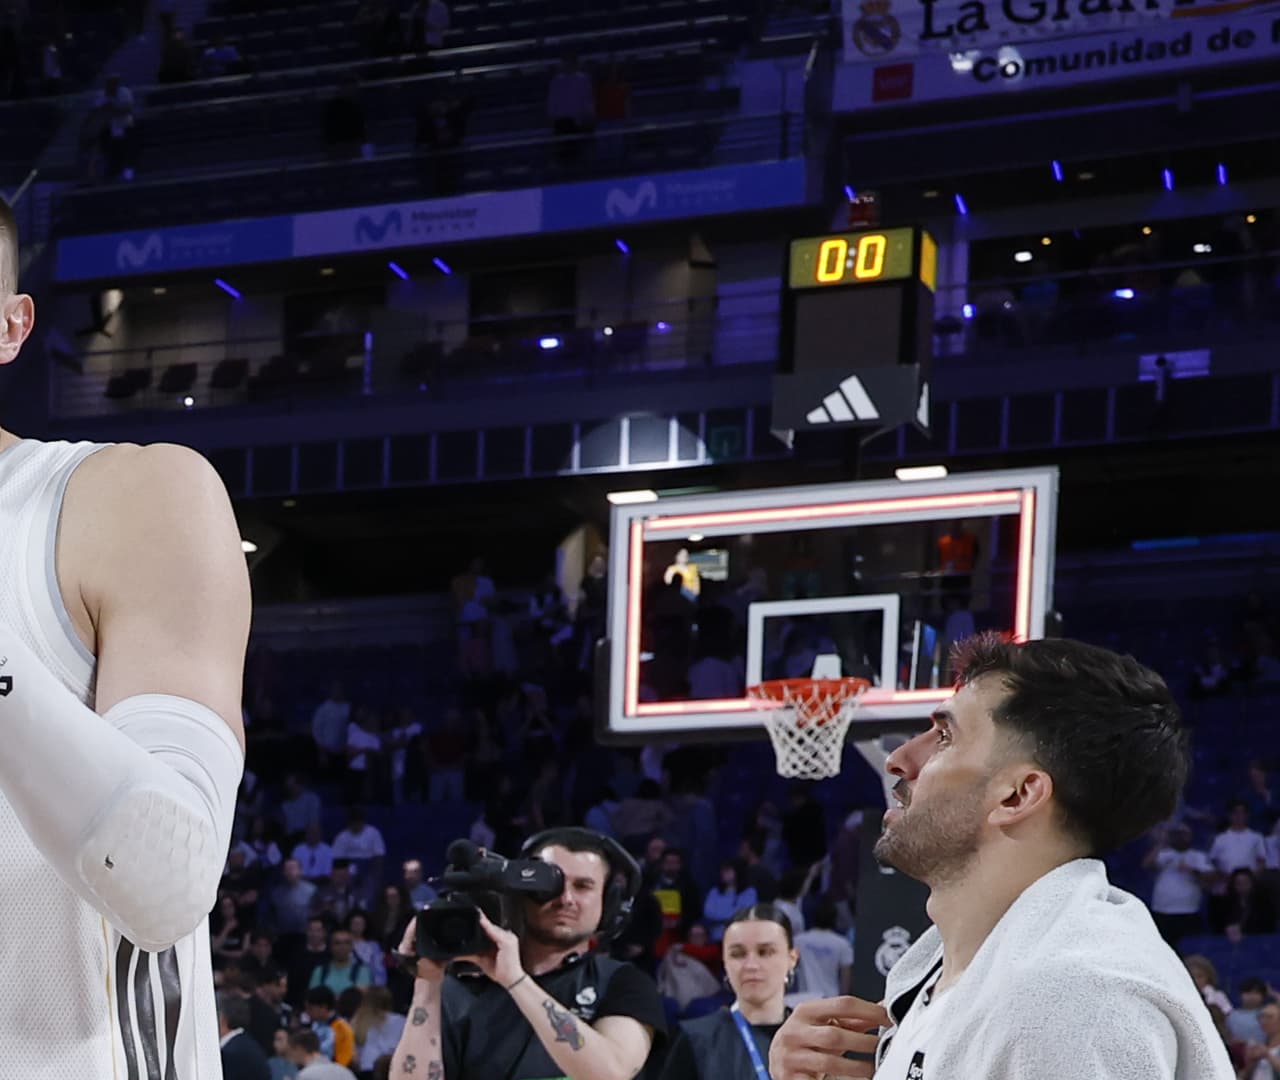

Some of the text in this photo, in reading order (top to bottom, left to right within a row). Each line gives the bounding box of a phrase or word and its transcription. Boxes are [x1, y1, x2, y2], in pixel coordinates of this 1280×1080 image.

[919, 0, 988, 41] La
[973, 31, 1192, 83] Comunidad
[1207, 26, 1257, 52] de
